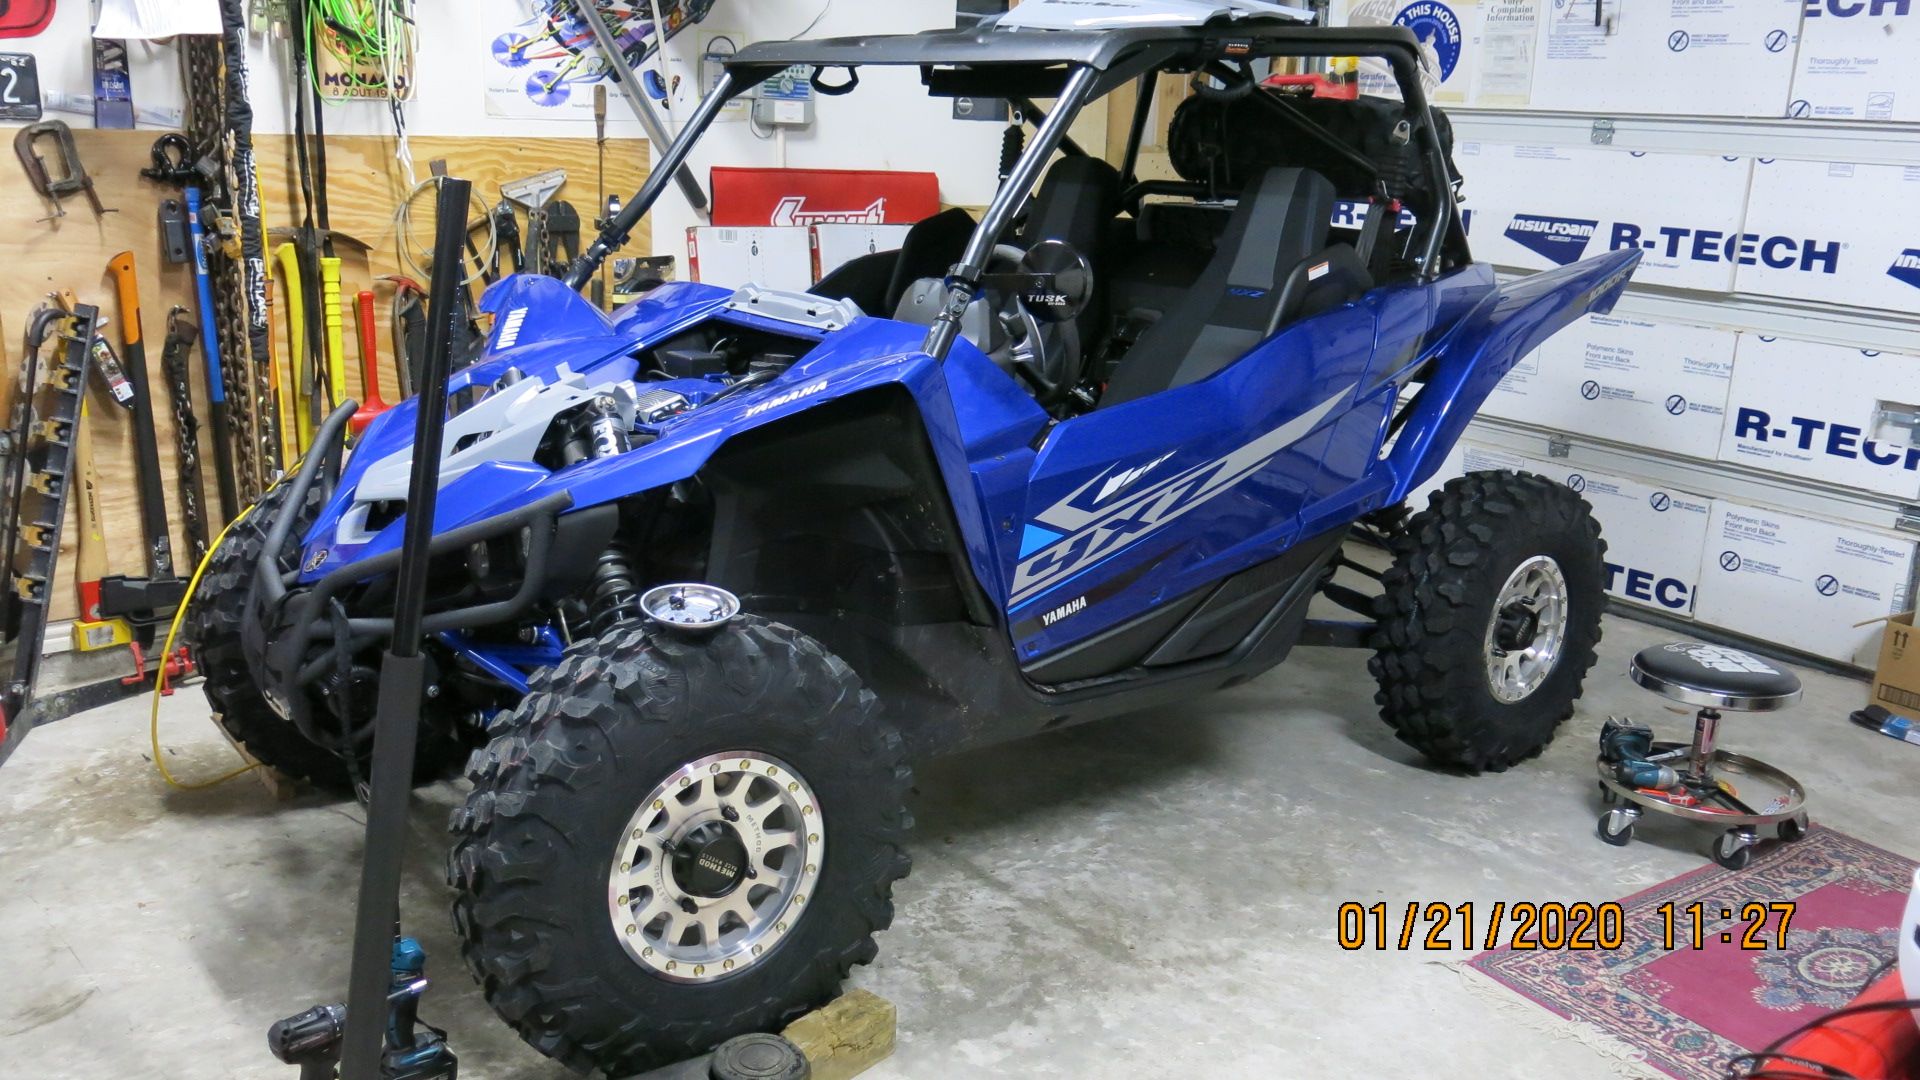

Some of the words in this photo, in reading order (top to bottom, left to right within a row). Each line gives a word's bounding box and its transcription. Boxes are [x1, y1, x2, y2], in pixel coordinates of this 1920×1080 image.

[1406, 4, 1431, 20] THIS
[1432, 6, 1459, 44] HOUSE
[1487, 13, 1535, 22] Information
[1491, 5, 1534, 15] Complaint
[0, 67, 21, 103] 2
[1028, 294, 1067, 303] TUSK
[495, 306, 528, 350] YAMAHA
[744, 380, 828, 418] YAMAHA
[1042, 596, 1087, 626] YAMAHA
[746, 814, 762, 853] METHOD
[699, 858, 735, 878] METHOD
